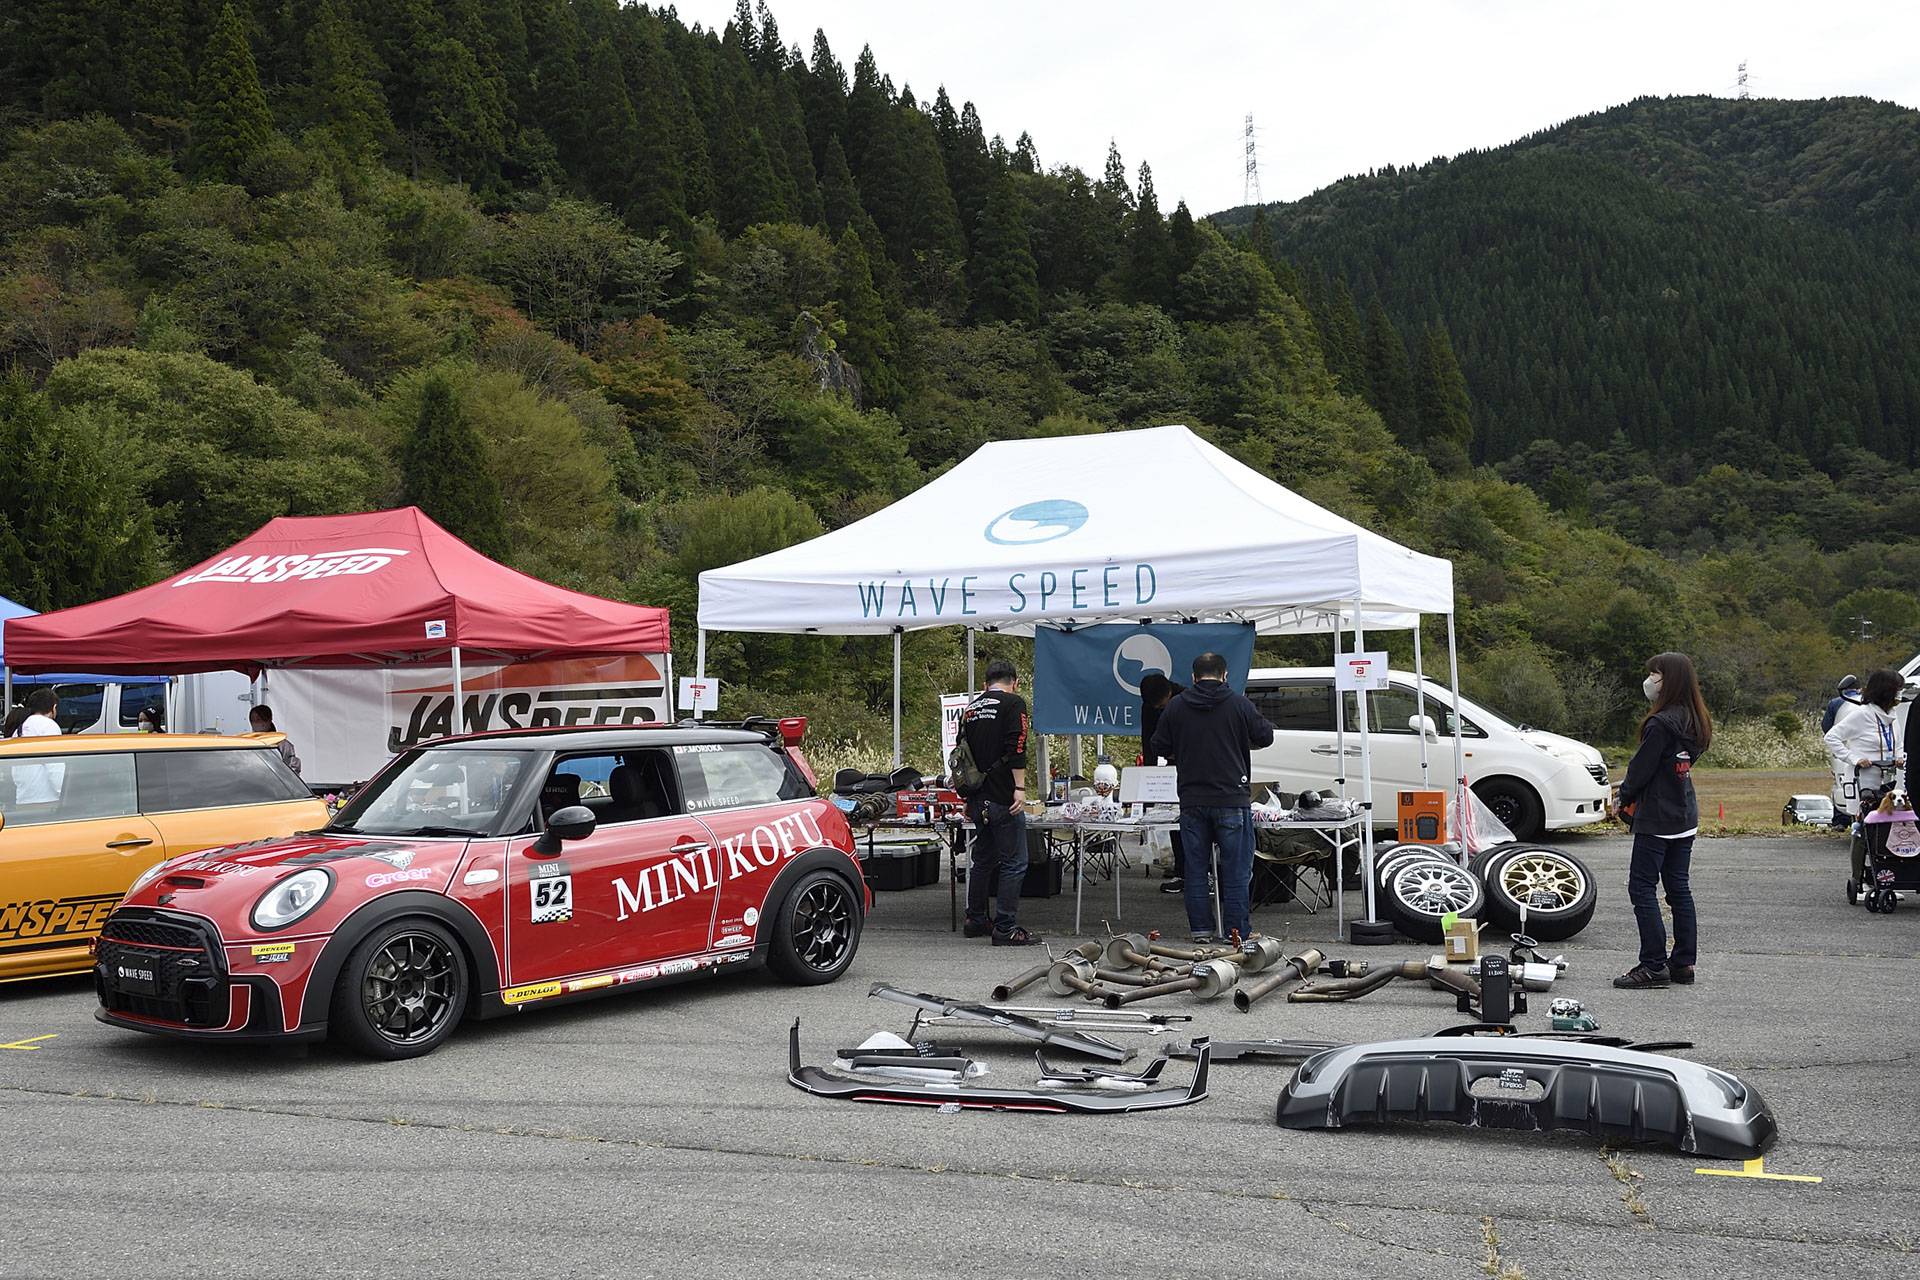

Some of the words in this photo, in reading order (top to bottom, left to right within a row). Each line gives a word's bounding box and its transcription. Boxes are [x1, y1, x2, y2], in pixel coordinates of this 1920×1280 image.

[172, 549, 408, 588] JANSPEED
[857, 575, 978, 618] WAVE
[1008, 563, 1157, 613] SPEED
[1074, 705, 1133, 726] WAVE
[682, 744, 724, 754] F.MORIOKA
[696, 798, 716, 810] WAVE
[718, 795, 740, 807] SPEED
[537, 863, 560, 874] MINI
[611, 846, 719, 922] MINI
[721, 808, 824, 881] KOFU
[365, 867, 432, 888] Creer
[536, 880, 568, 908] 52
[260, 945, 292, 953] DUNLOP
[125, 967, 138, 979] WAVE
[138, 969, 154, 981] SPEED
[663, 961, 694, 975] NITRON
[515, 985, 557, 998] DUNLOP
